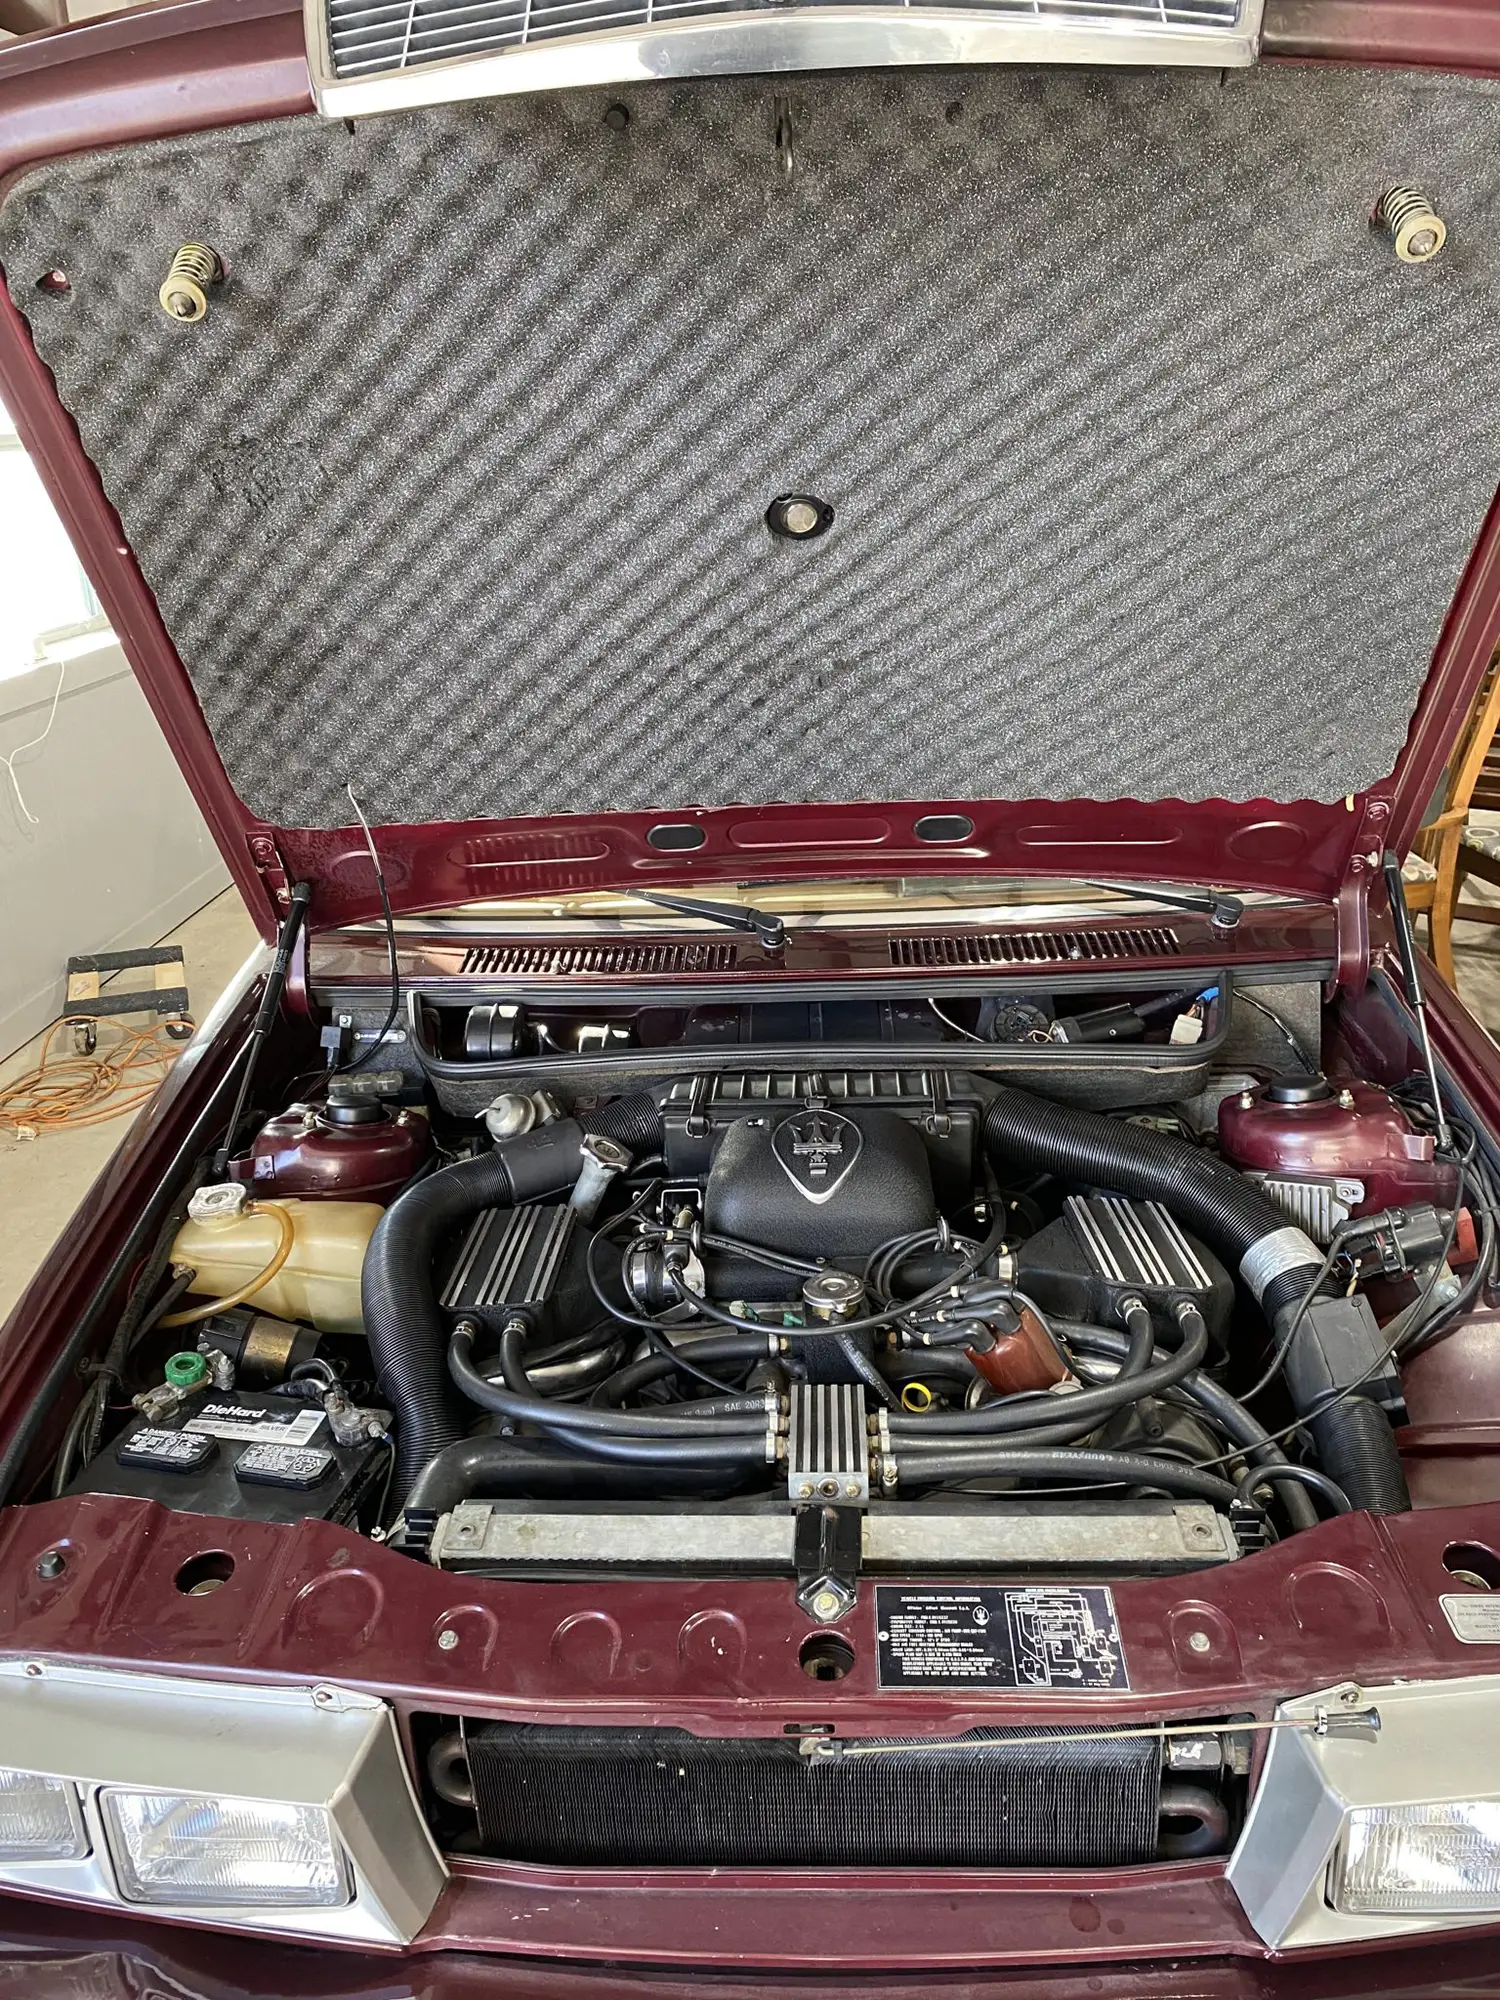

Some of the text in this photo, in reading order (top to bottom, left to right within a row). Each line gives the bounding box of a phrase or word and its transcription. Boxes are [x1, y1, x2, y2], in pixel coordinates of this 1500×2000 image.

[201, 1404, 267, 1418] DieHard
[724, 1403, 742, 1413] SAE
[745, 1399, 765, 1410] 20R3
[1051, 1451, 1114, 1462] GOODYEAR
[1119, 1456, 1130, 1464] BY
